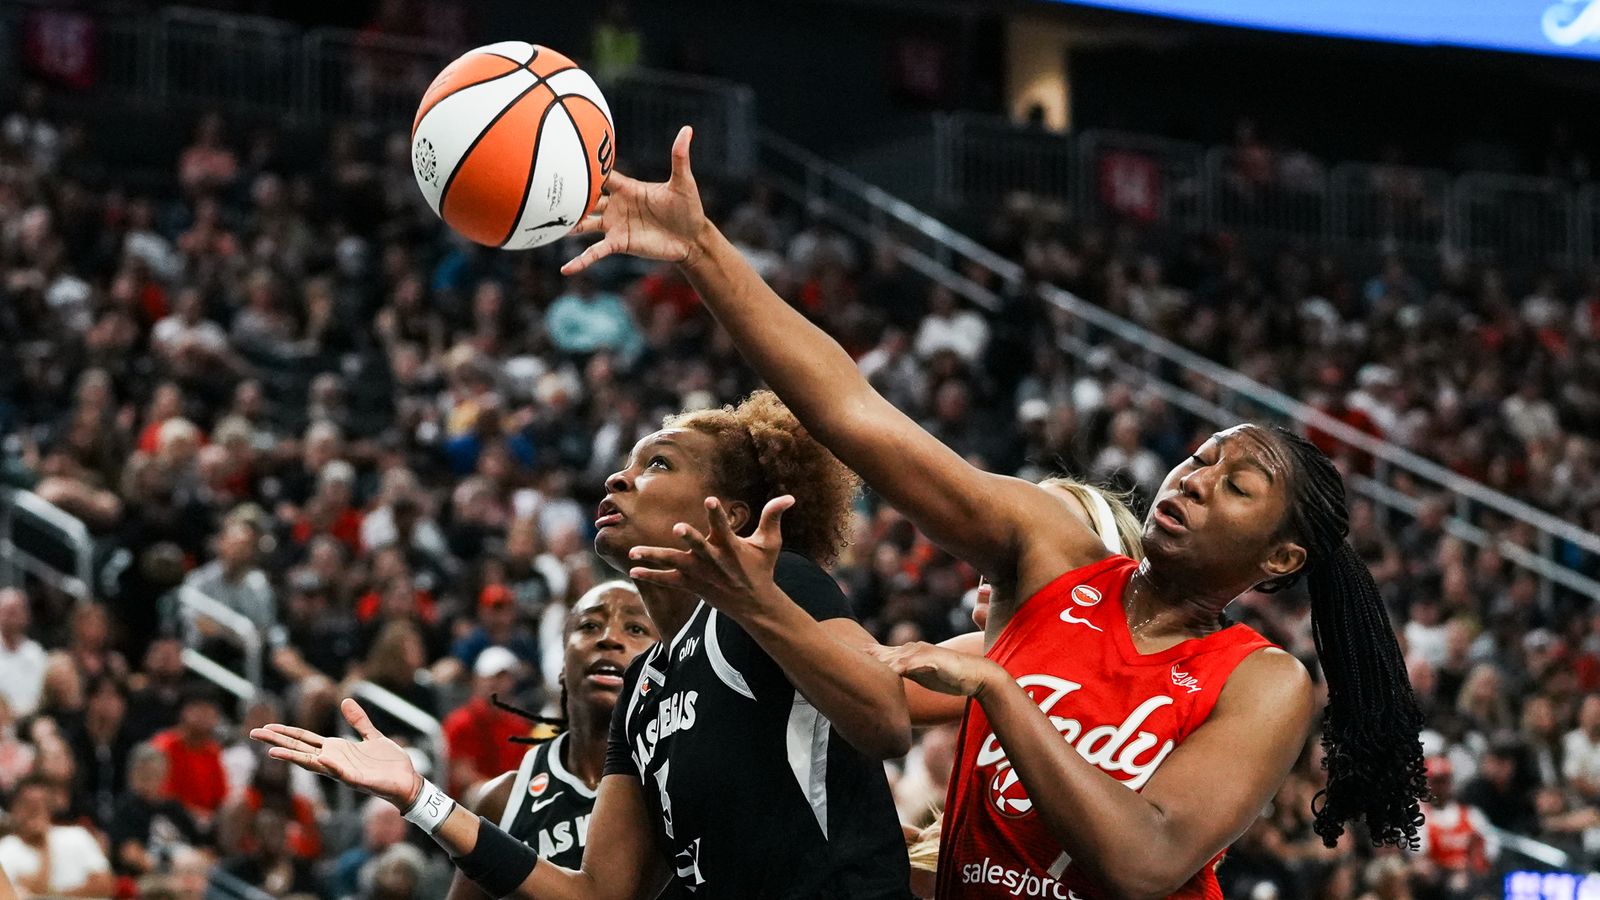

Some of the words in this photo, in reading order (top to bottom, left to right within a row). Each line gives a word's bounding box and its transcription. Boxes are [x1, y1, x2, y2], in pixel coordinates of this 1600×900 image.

[678, 636, 700, 662] ally
[1171, 662, 1202, 694] Lilly
[524, 820, 574, 859] AS
